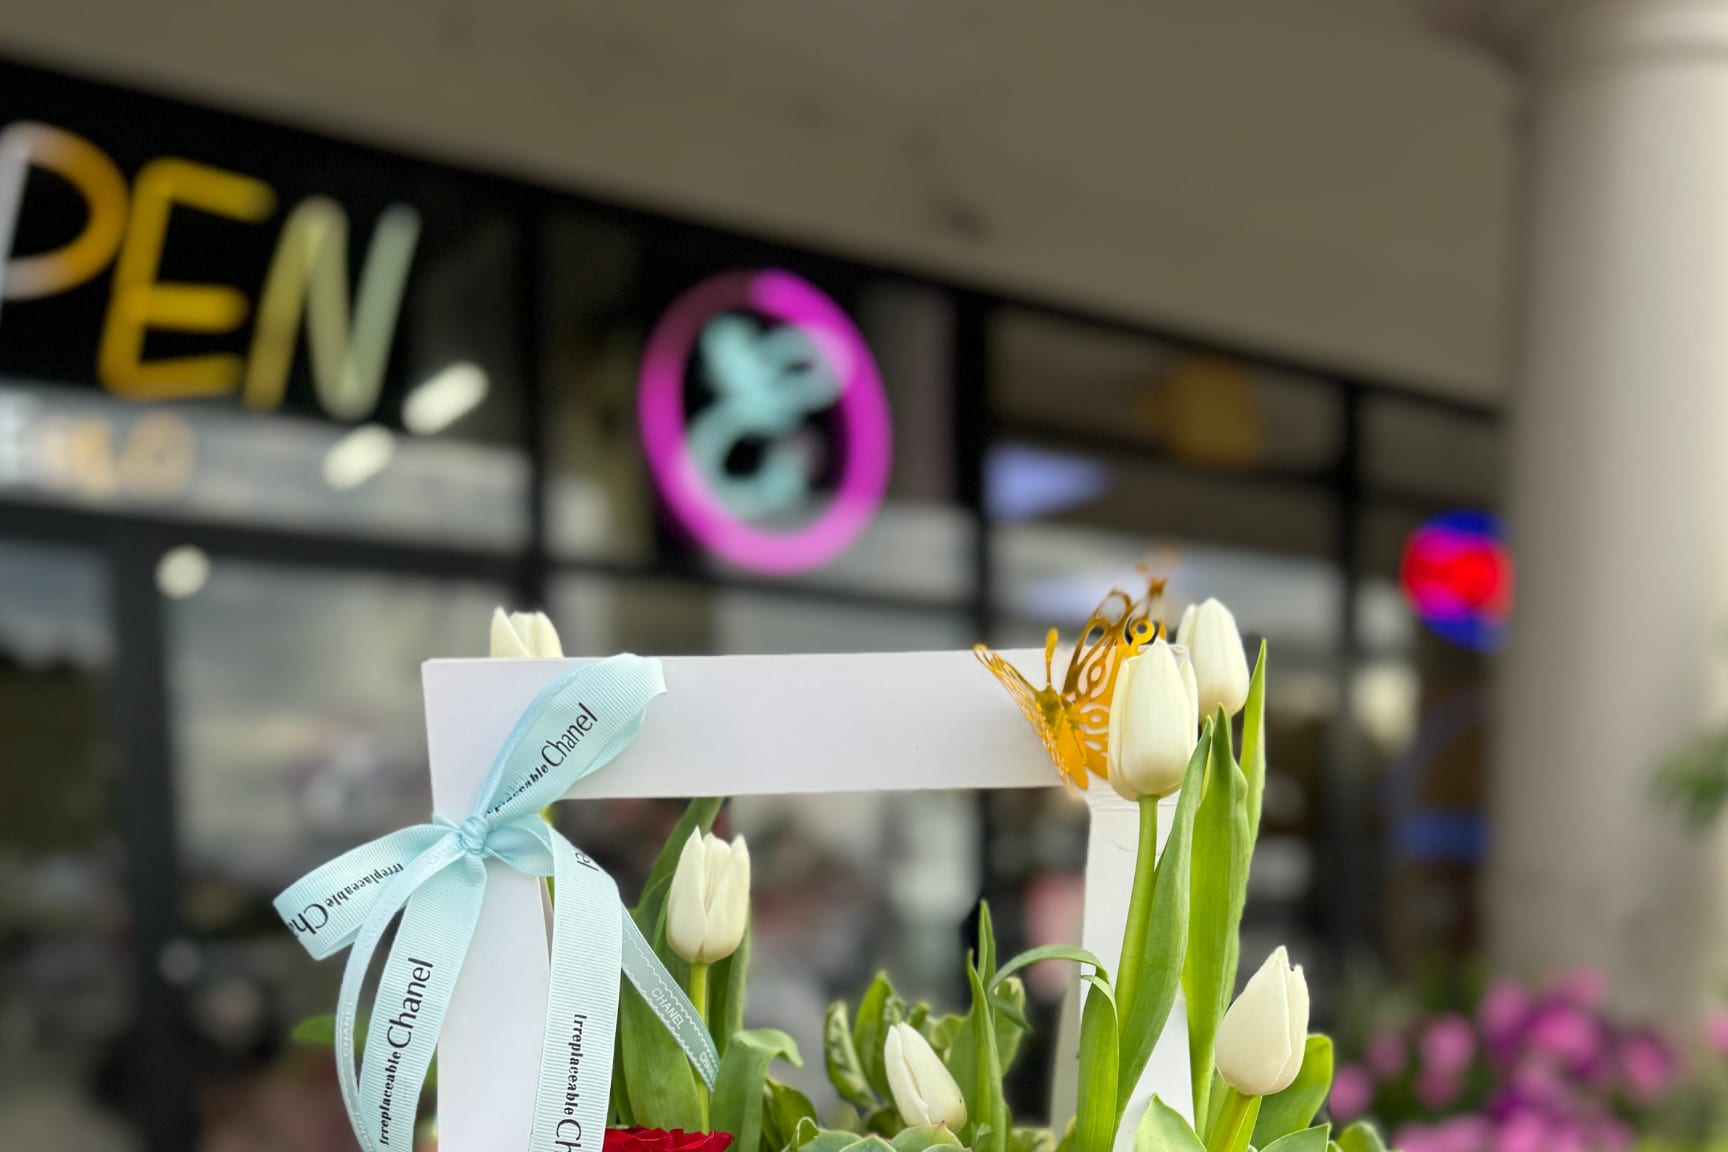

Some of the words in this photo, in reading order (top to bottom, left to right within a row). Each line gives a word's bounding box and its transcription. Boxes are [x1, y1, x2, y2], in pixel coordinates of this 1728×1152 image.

[541, 702, 598, 767] Chanel
[326, 862, 404, 907] Irreplaceable
[387, 957, 433, 1049] Chanel
[651, 987, 685, 1030] CHANEL
[379, 1051, 401, 1146] Irreplaceable
[563, 1013, 587, 1116] Irreplaceable
